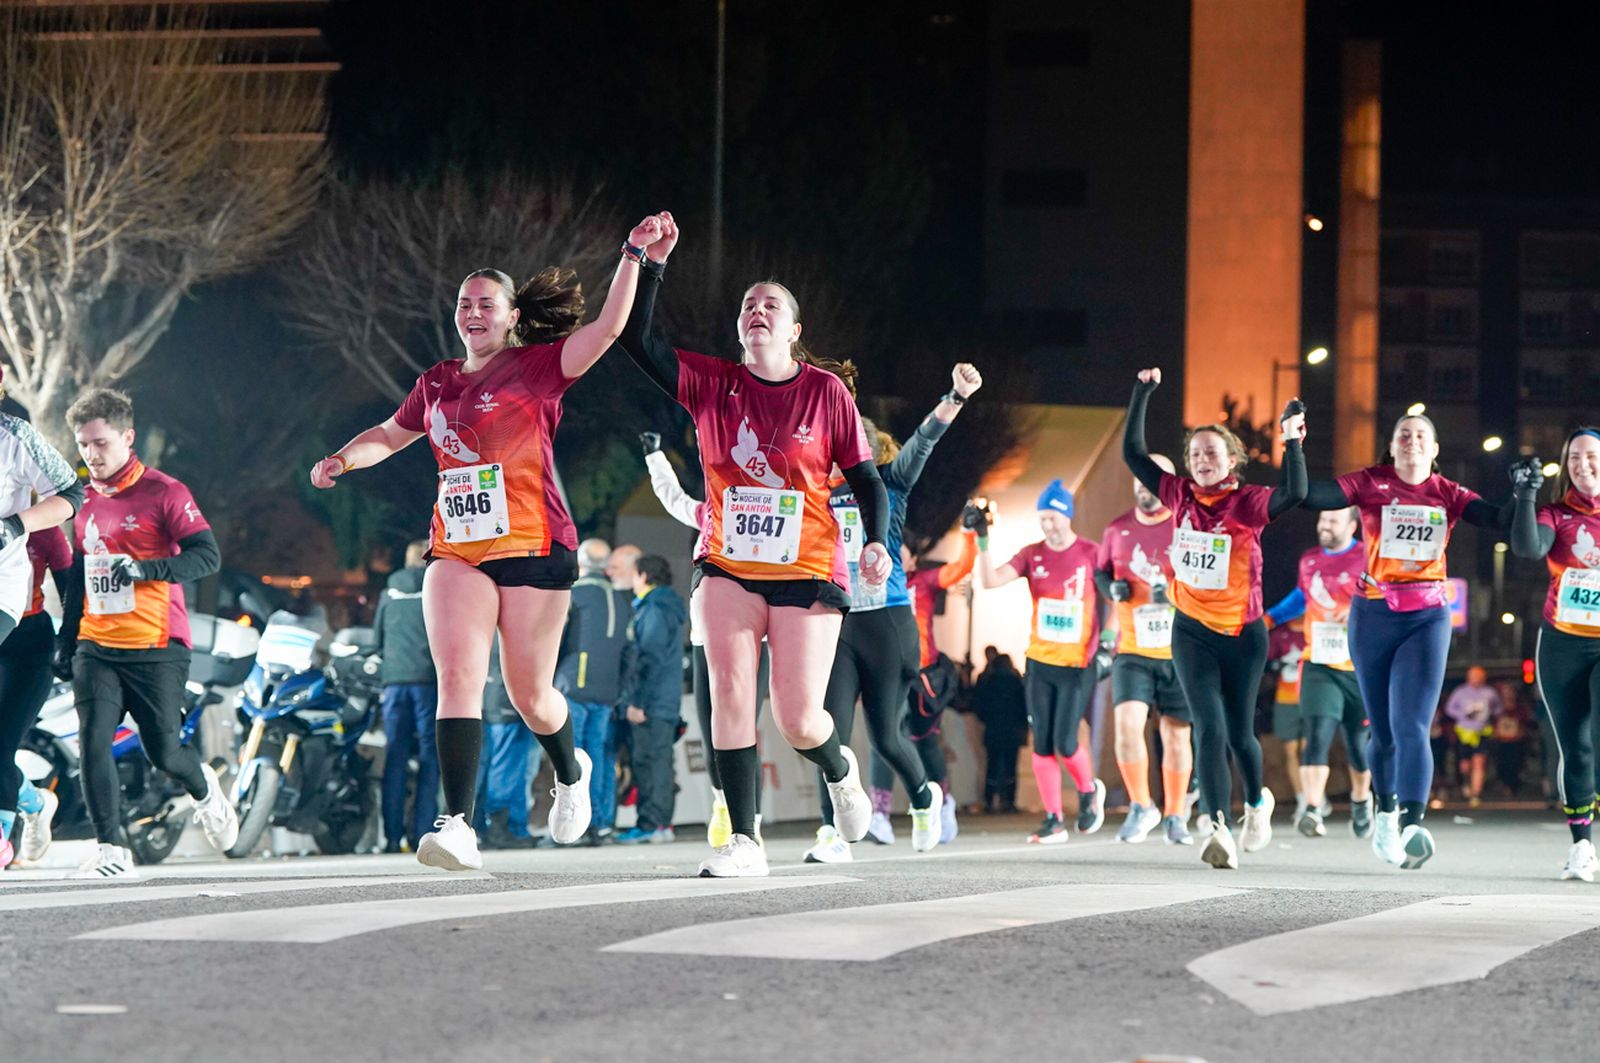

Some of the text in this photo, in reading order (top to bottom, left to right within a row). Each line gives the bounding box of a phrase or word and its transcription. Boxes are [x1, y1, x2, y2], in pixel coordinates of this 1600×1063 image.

[442, 434, 460, 455] 43
[745, 456, 766, 477] 43
[462, 475, 471, 483] DE
[445, 492, 491, 518] 3646
[730, 503, 745, 512] SAN
[739, 495, 761, 503] NOCHE
[762, 496, 772, 504] DE
[736, 513, 785, 538] 3647
[1396, 524, 1433, 542] 2212
[1182, 551, 1216, 570] 4512
[1584, 552, 1600, 567] 43
[88, 576, 120, 594] 609
